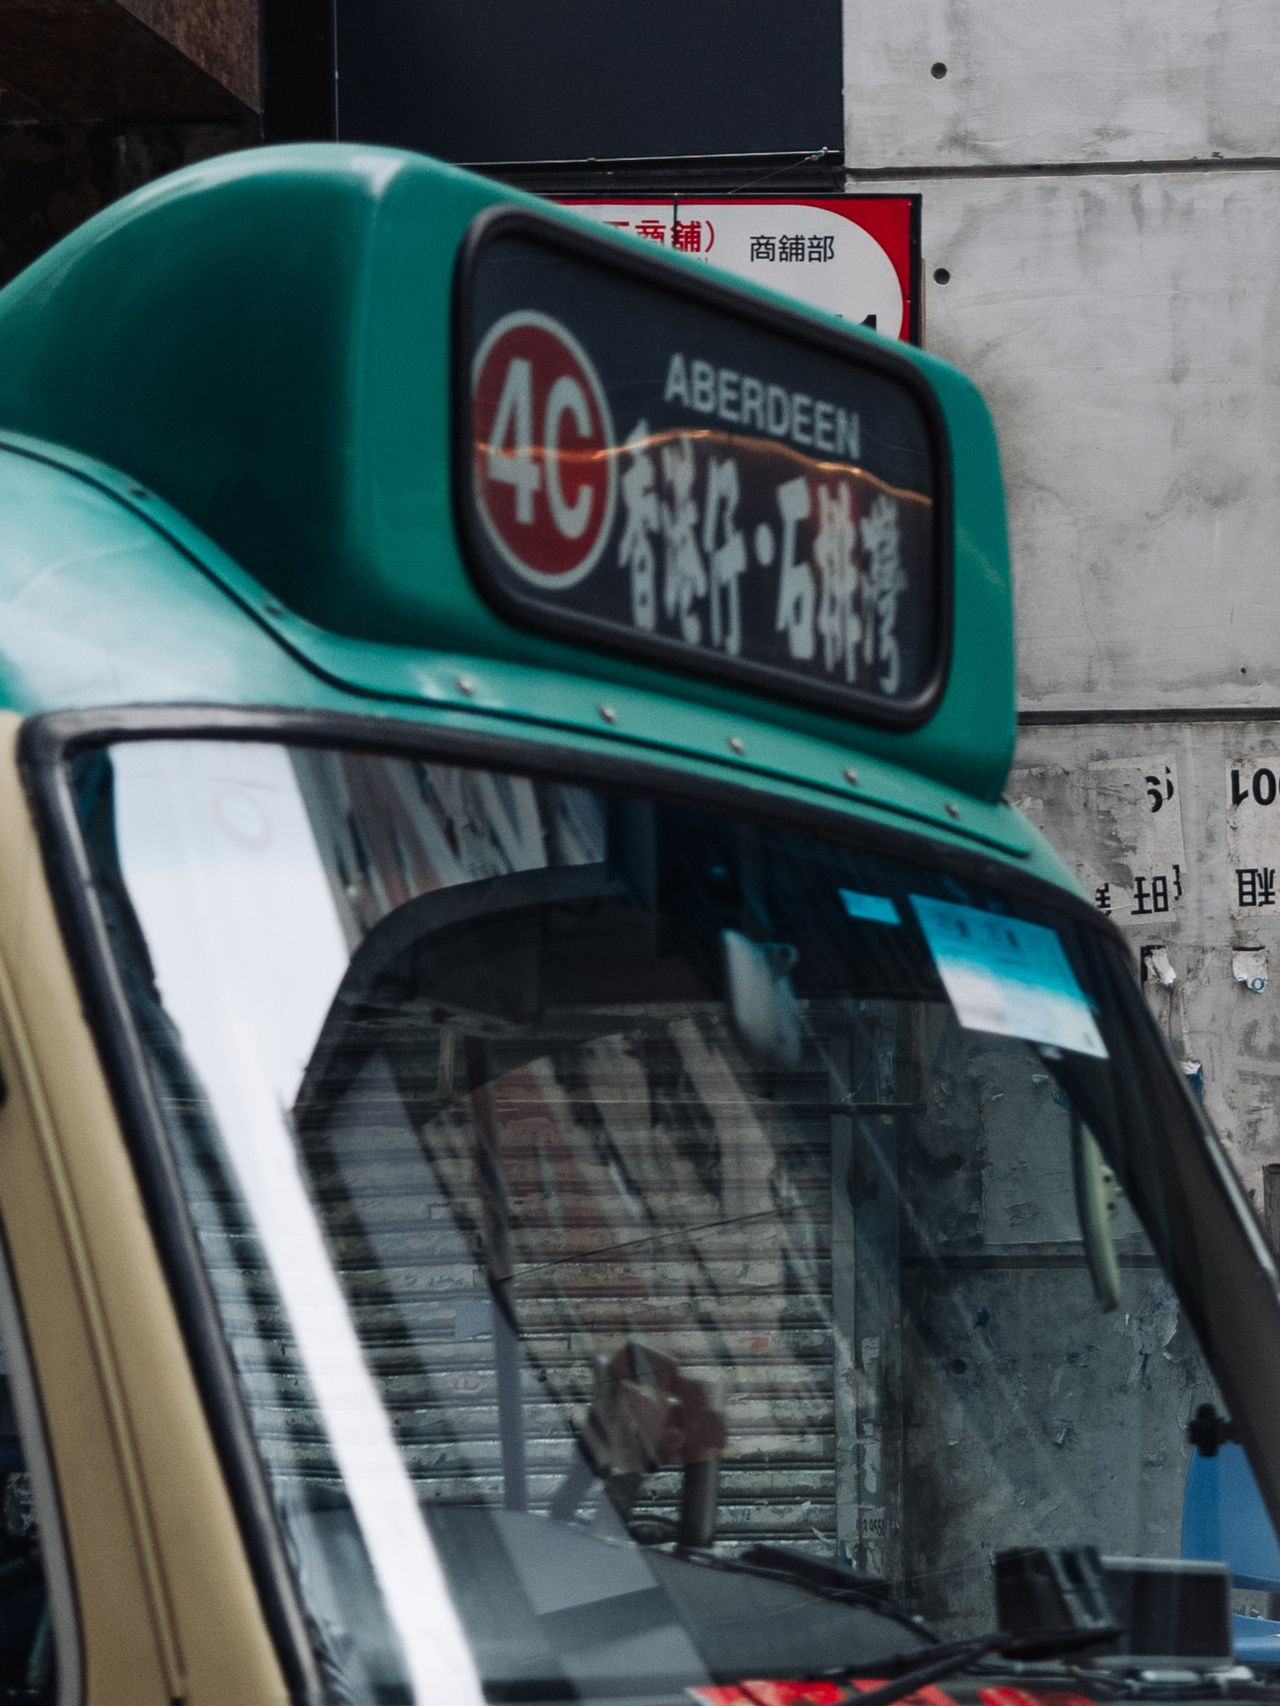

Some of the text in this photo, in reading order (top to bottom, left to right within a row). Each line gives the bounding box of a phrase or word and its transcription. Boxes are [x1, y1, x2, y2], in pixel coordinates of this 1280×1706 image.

[749, 234, 836, 263] 商舖部
[487, 357, 594, 540] 4C
[664, 352, 862, 460] ABERDEEN
